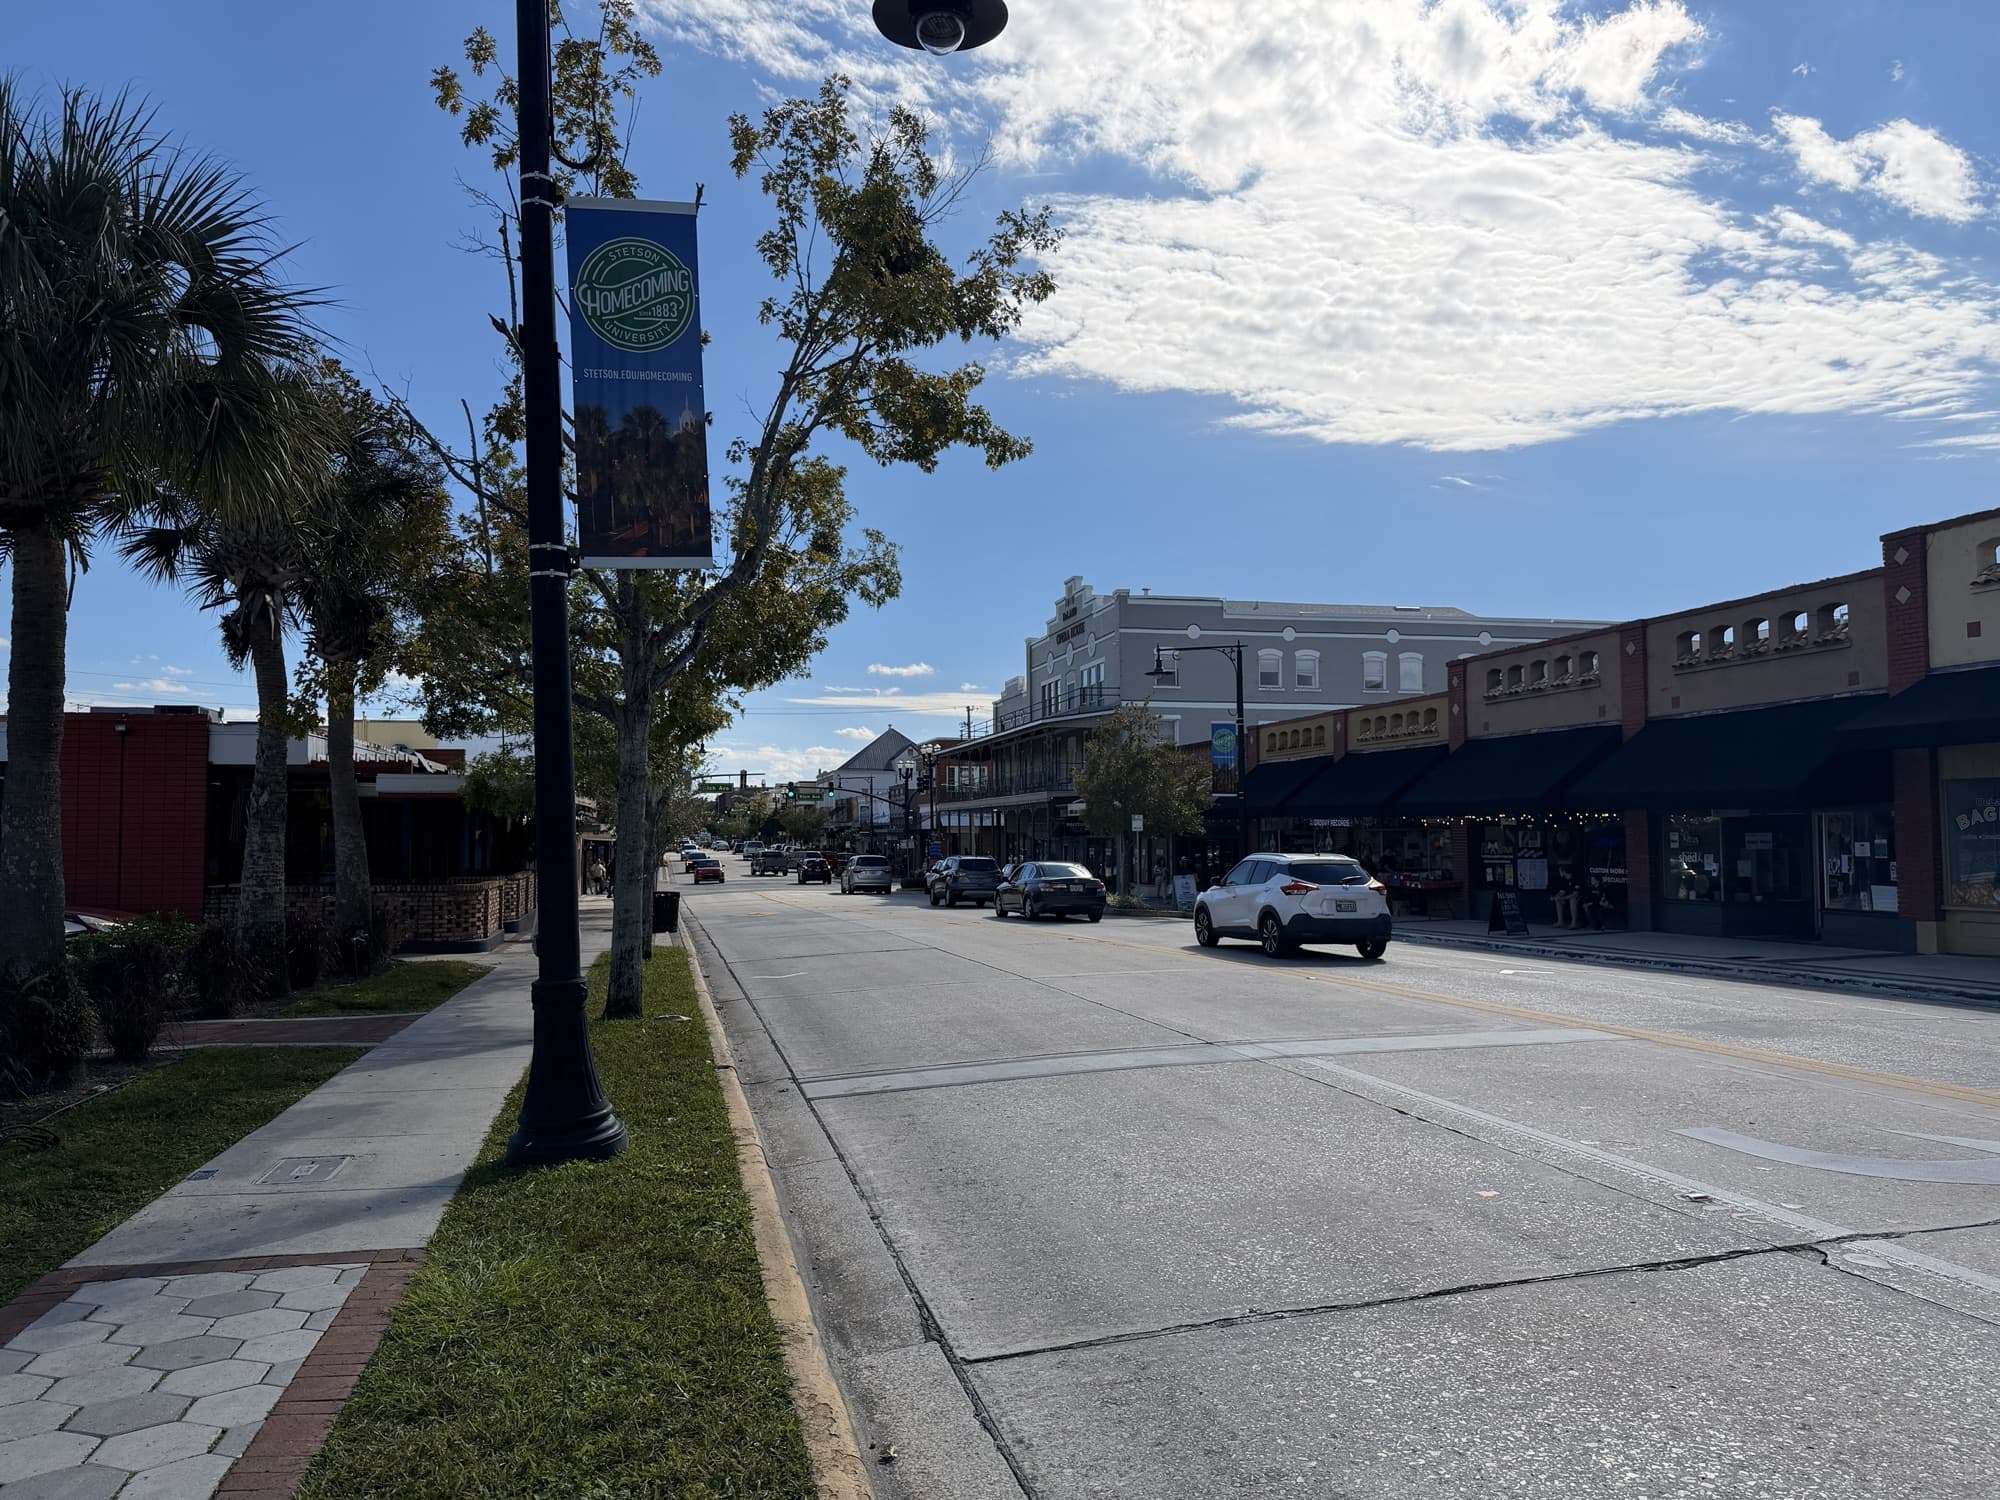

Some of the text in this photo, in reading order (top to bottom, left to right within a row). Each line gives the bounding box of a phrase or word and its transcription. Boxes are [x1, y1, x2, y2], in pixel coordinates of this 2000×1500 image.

[608, 247, 661, 262] STETSON
[577, 269, 689, 316] HOMECOMING
[652, 301, 678, 318] 1883
[604, 320, 673, 343] UNIVERSITY
[583, 368, 693, 383] STETSON.EDU/HOMECOMING
[1955, 806, 2000, 831] BAG
